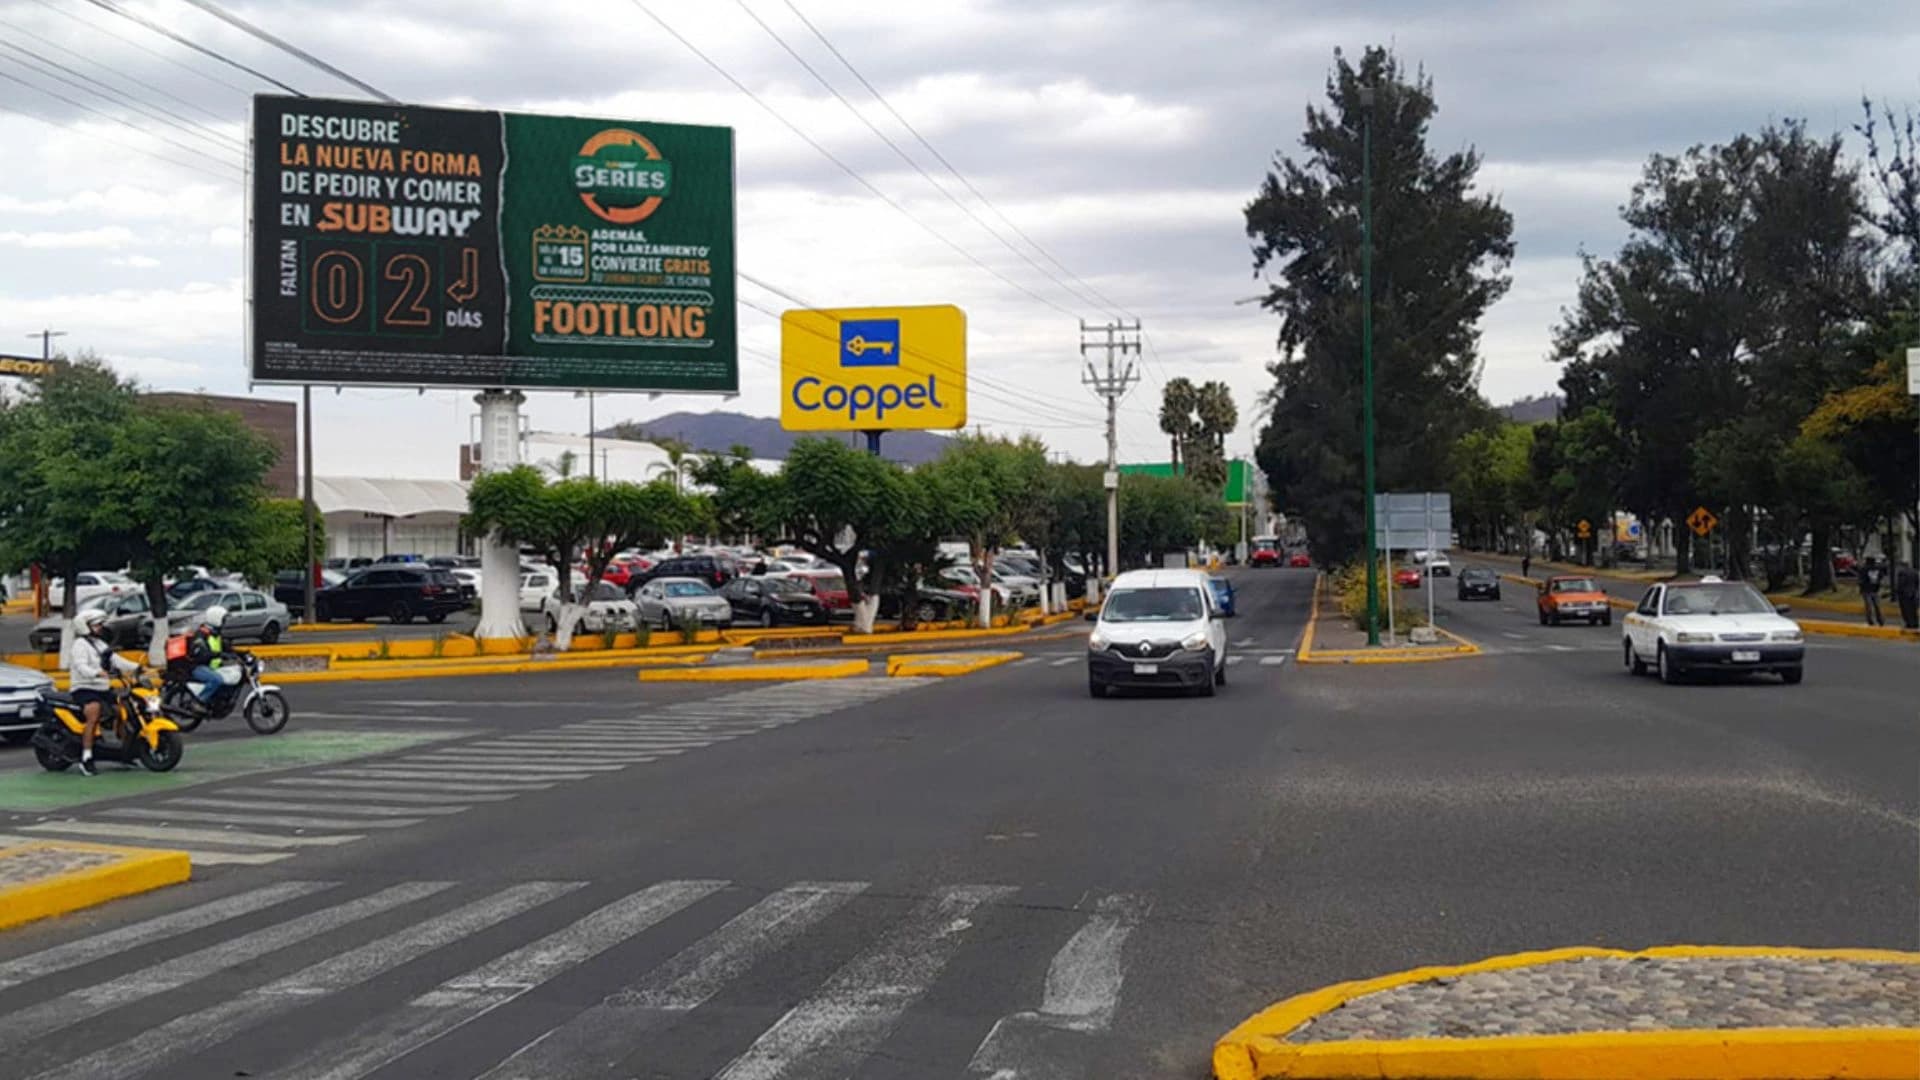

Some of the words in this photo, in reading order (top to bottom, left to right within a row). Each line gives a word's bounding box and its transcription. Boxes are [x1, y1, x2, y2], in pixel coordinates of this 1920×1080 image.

[281, 113, 400, 143] DESCUBRE
[280, 143, 309, 166] LA
[316, 145, 394, 171] NUEVA
[400, 150, 481, 176] FORMA
[281, 171, 311, 194] DE
[315, 173, 380, 198] PEDIR
[386, 177, 399, 199] Y
[403, 178, 481, 204] COMER
[281, 203, 310, 226] EN
[316, 202, 481, 236] SUBWAY
[559, 246, 583, 266] 15
[592, 243, 616, 252] POR
[280, 239, 297, 296] FALTAN
[591, 256, 661, 272] CONVIERTE
[664, 259, 711, 274] GRATIS
[446, 309, 482, 328] DÍAS
[534, 300, 706, 337] FOOTLONG
[792, 373, 942, 421] Coppel
